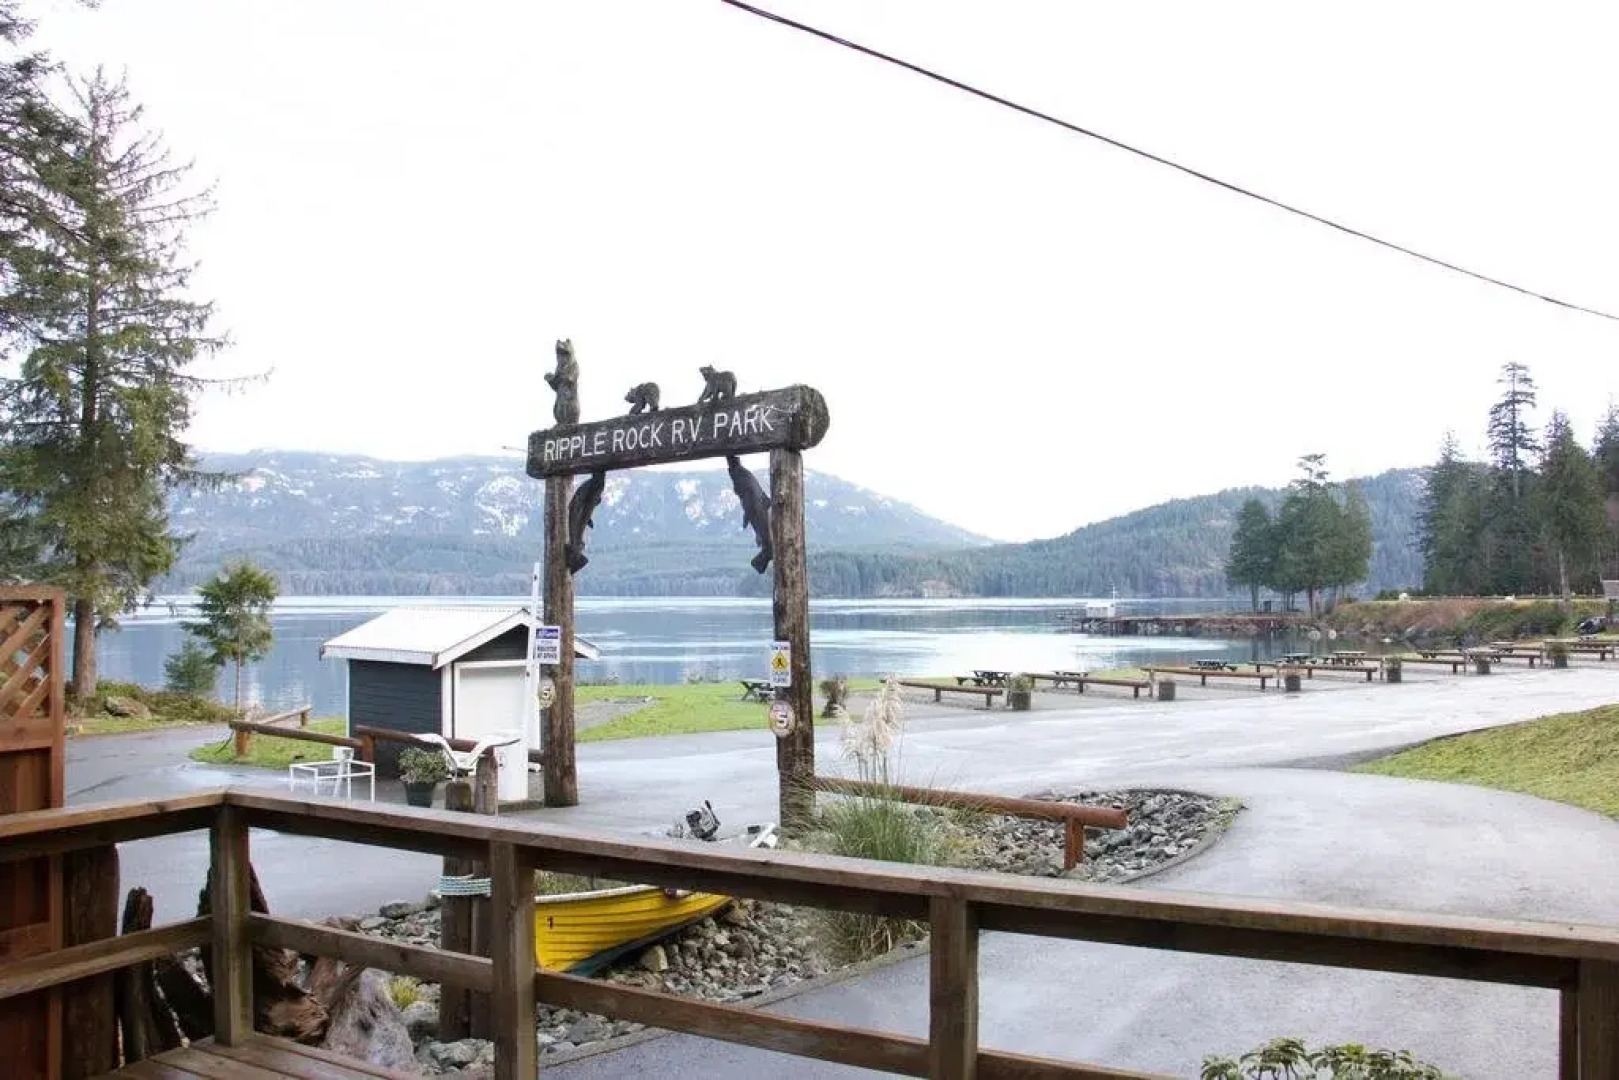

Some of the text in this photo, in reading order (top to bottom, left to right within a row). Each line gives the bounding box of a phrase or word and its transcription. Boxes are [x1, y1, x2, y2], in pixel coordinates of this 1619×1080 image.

[544, 432, 607, 461] RIPPLE
[612, 421, 664, 452] ROCK
[713, 408, 774, 439] PARK
